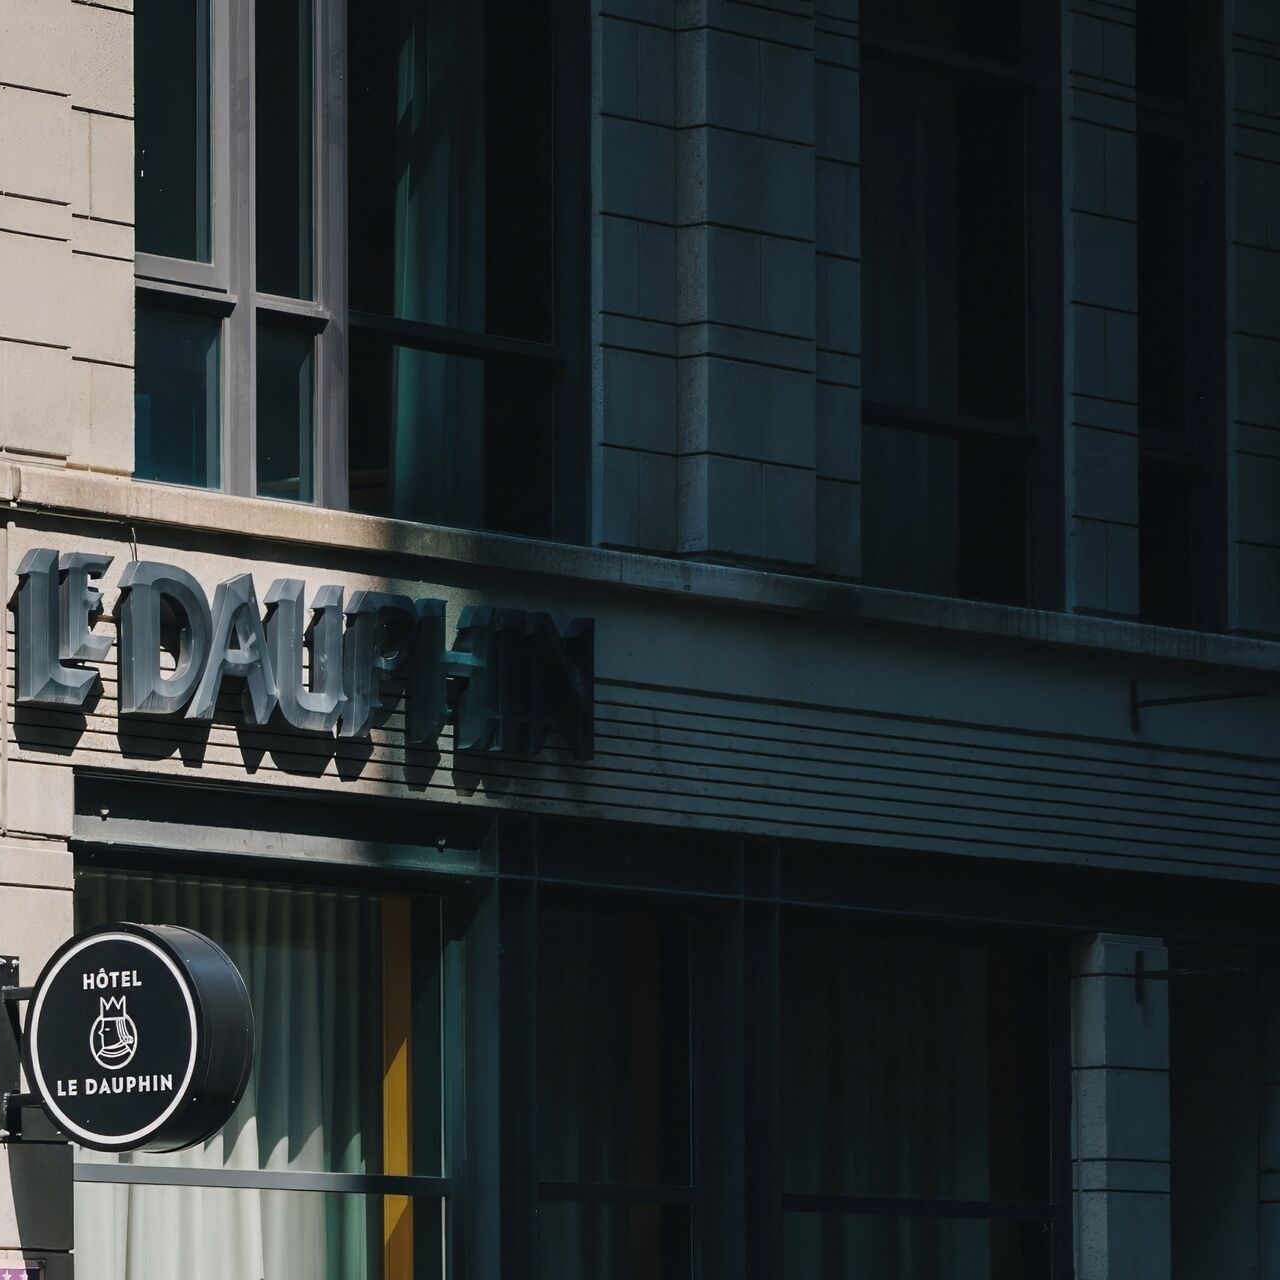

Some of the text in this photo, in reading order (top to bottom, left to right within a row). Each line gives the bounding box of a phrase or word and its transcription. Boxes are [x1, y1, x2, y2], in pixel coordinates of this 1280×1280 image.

[14, 548, 116, 704] LE
[115, 558, 596, 762] DAUPHIN
[82, 967, 142, 990] HÔTEL
[57, 1074, 173, 1096] LE DAUPHIN
